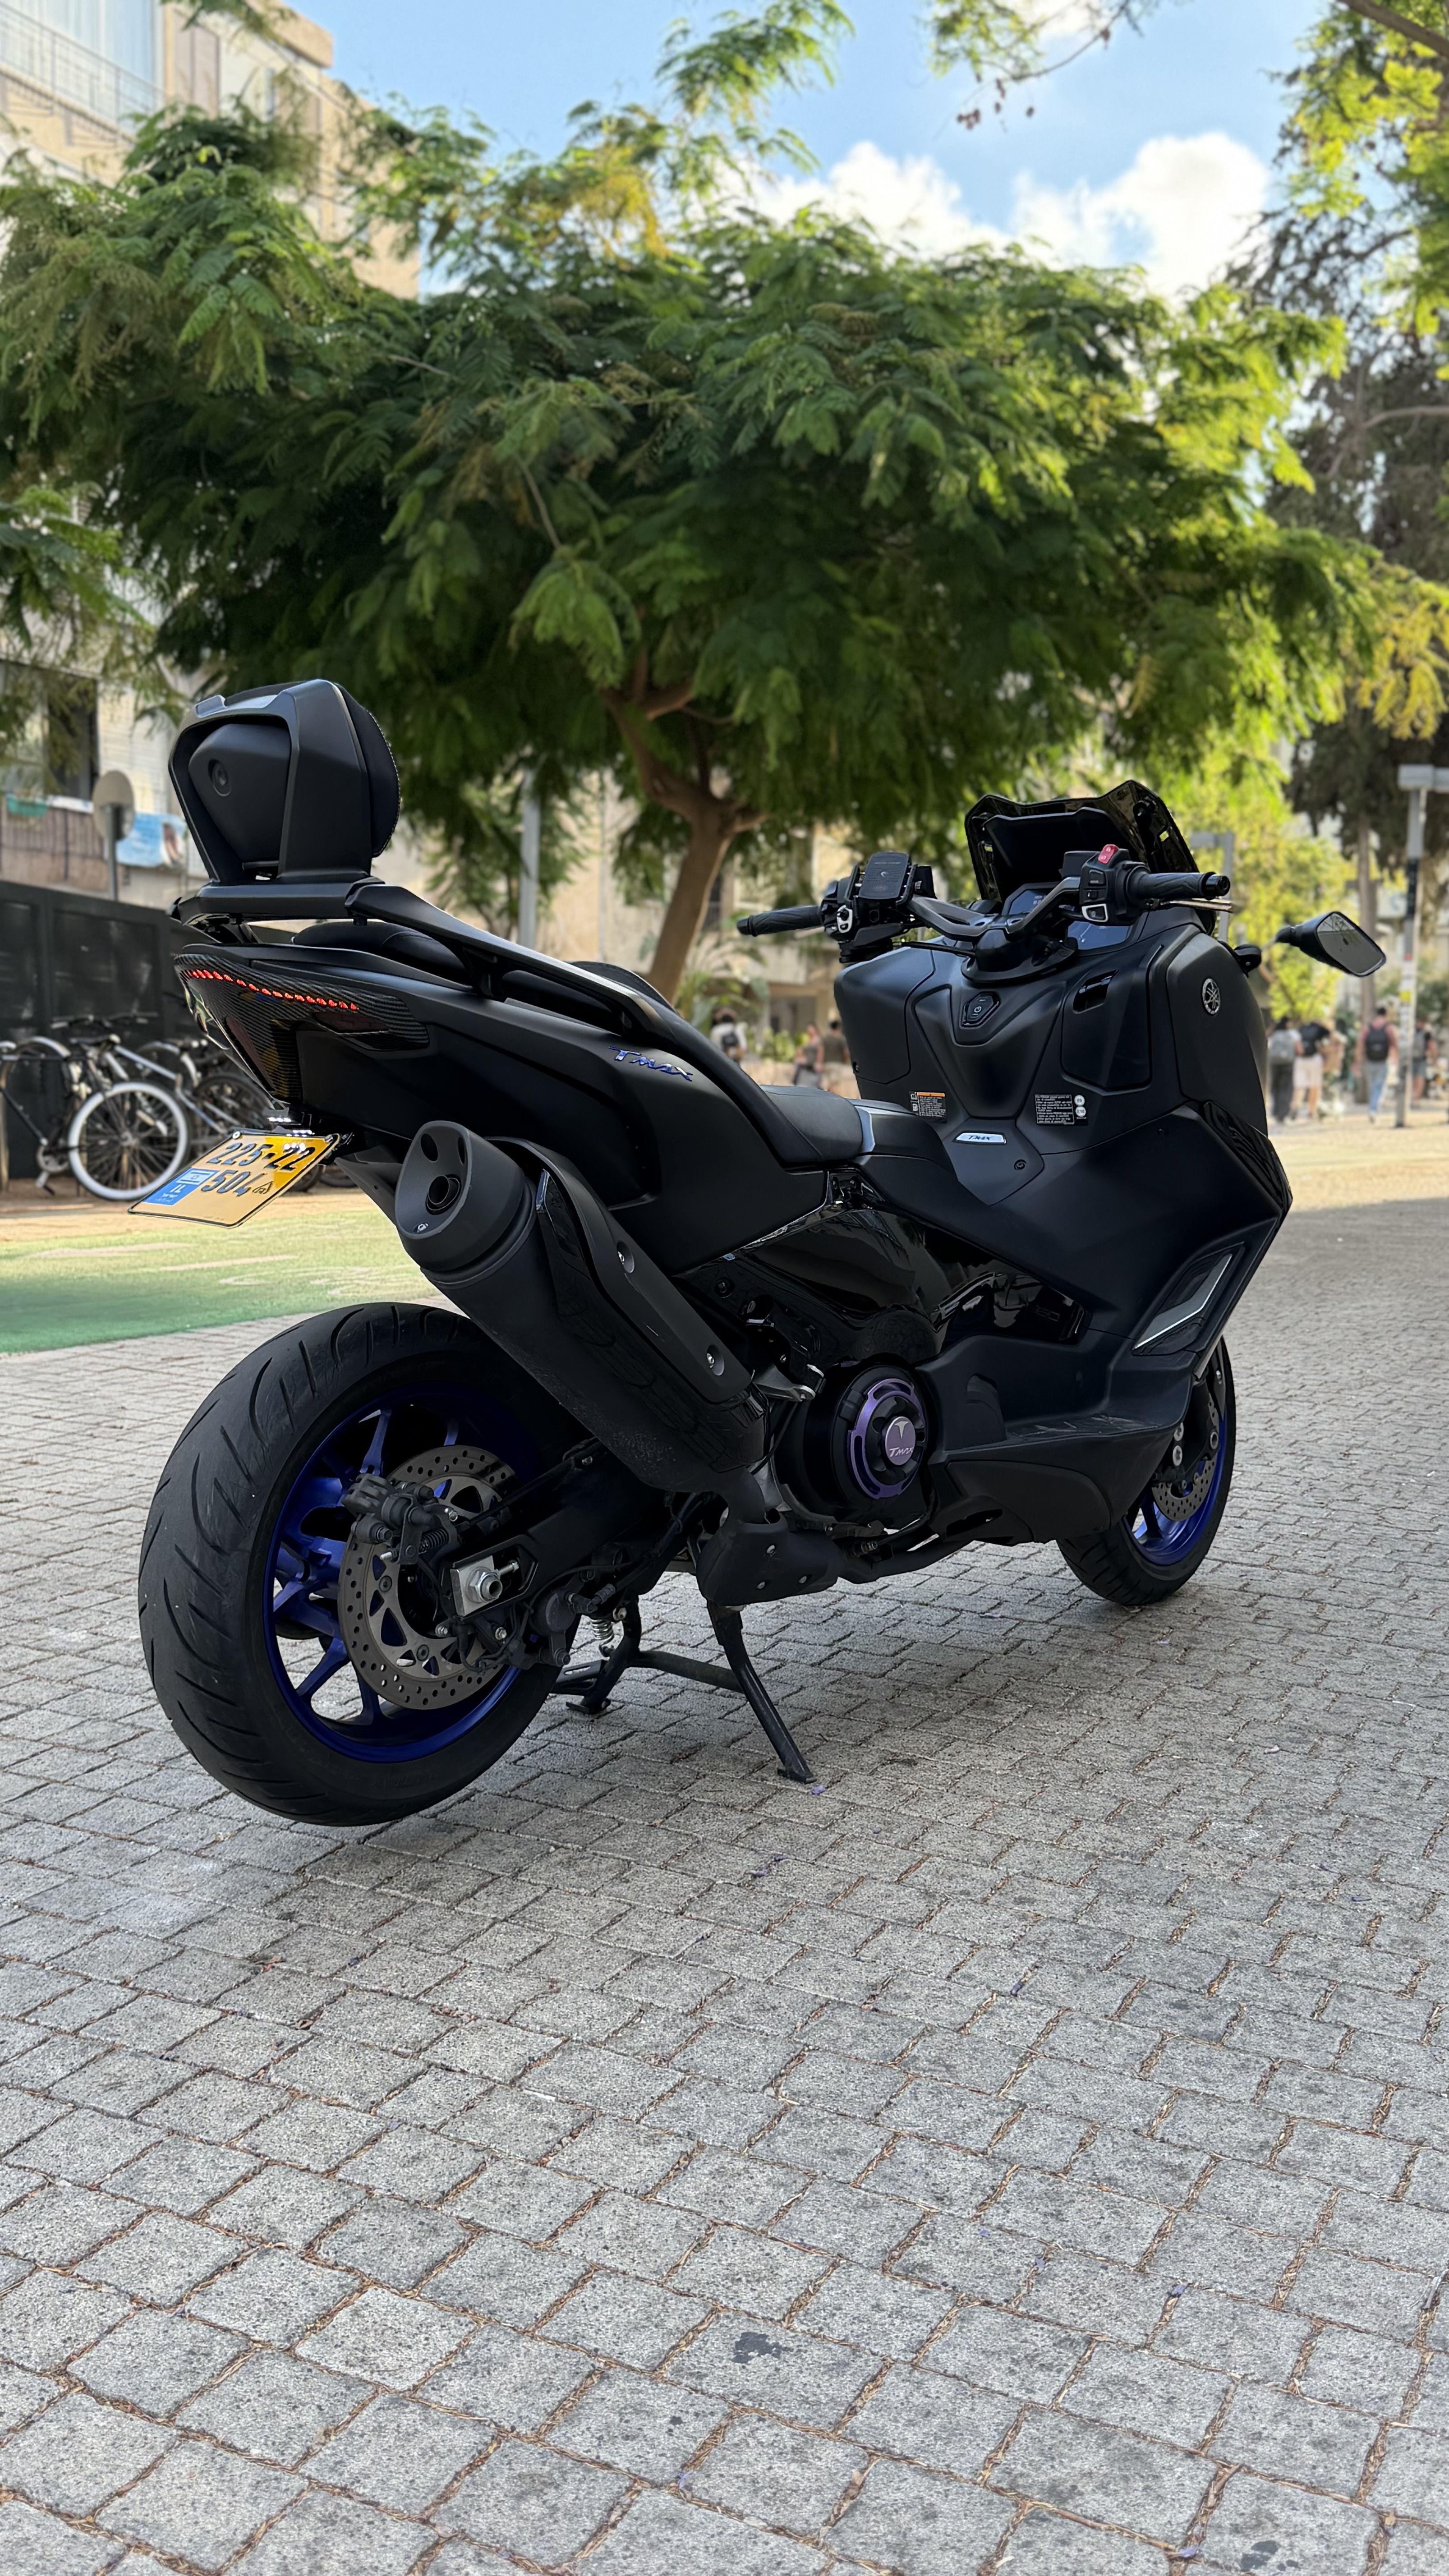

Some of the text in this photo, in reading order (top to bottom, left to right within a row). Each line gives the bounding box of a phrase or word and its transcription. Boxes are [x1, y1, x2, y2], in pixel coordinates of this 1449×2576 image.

[207, 1142, 316, 1171] 225-22
[170, 1184, 186, 1193] IL
[201, 1169, 267, 1197] 504
